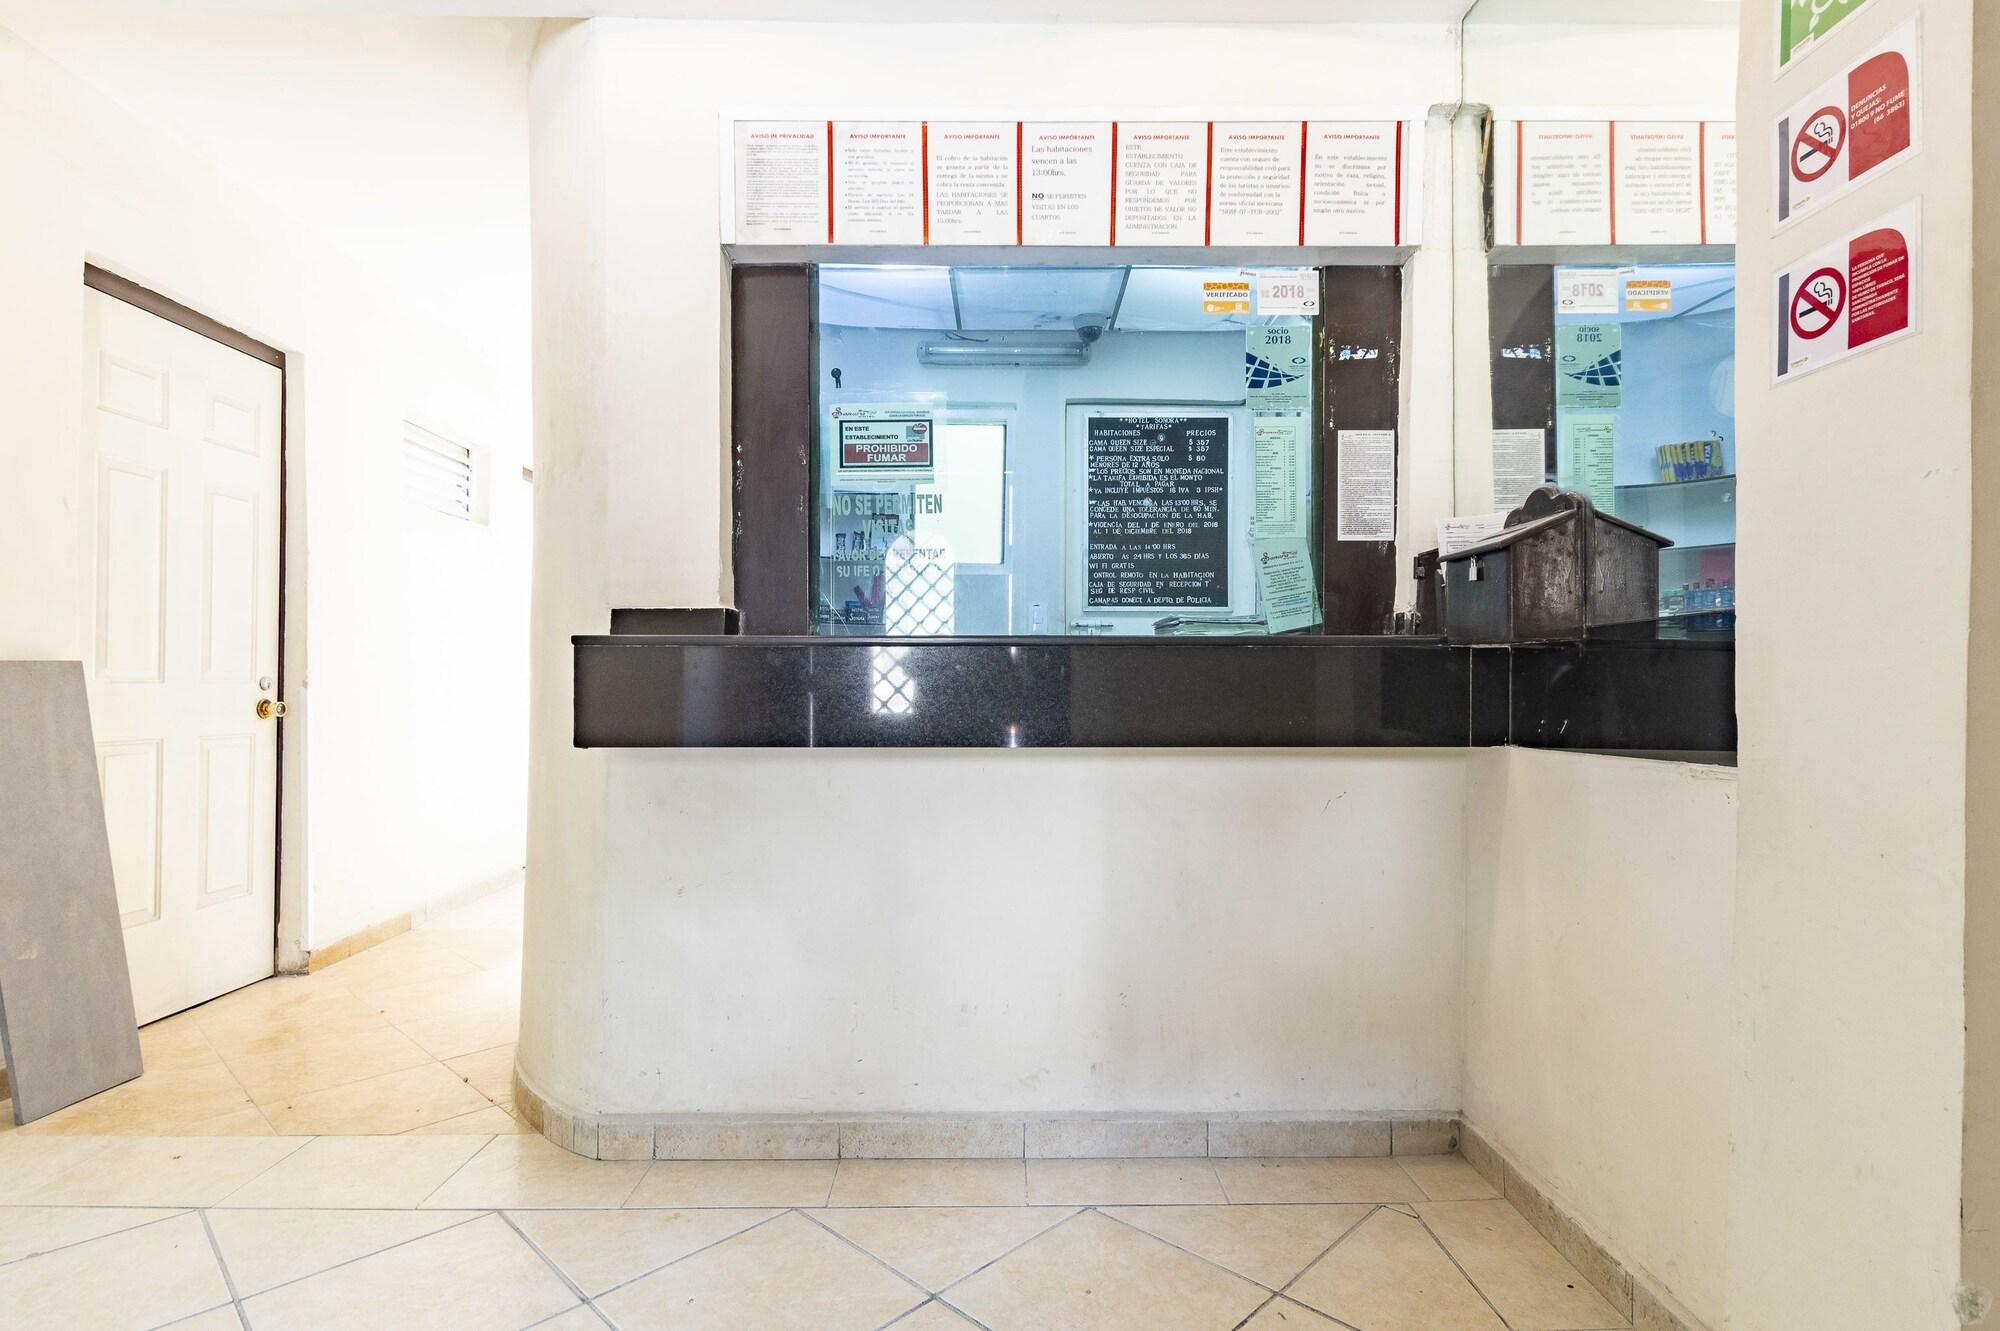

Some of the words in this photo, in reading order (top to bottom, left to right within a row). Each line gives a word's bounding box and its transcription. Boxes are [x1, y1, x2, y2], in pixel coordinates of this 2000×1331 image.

[1851, 84, 1886, 112] DENUNCIAS
[1851, 114, 1869, 129] 01800
[1876, 103, 1885, 113] NO
[1886, 90, 1904, 106] FUME
[1874, 113, 1884, 124] (66
[1032, 145, 1044, 153] Las
[1047, 145, 1092, 153] habitaciones
[1272, 285, 1304, 298] 2018
[1267, 327, 1289, 335] socio
[1265, 336, 1291, 344] 2018
[856, 444, 918, 452] PROHIBIDO
[867, 454, 906, 462] FUMAR
[832, 495, 851, 516] NO
[855, 495, 872, 515] SE
[836, 566, 850, 577] SU
[854, 565, 869, 576] IFE
